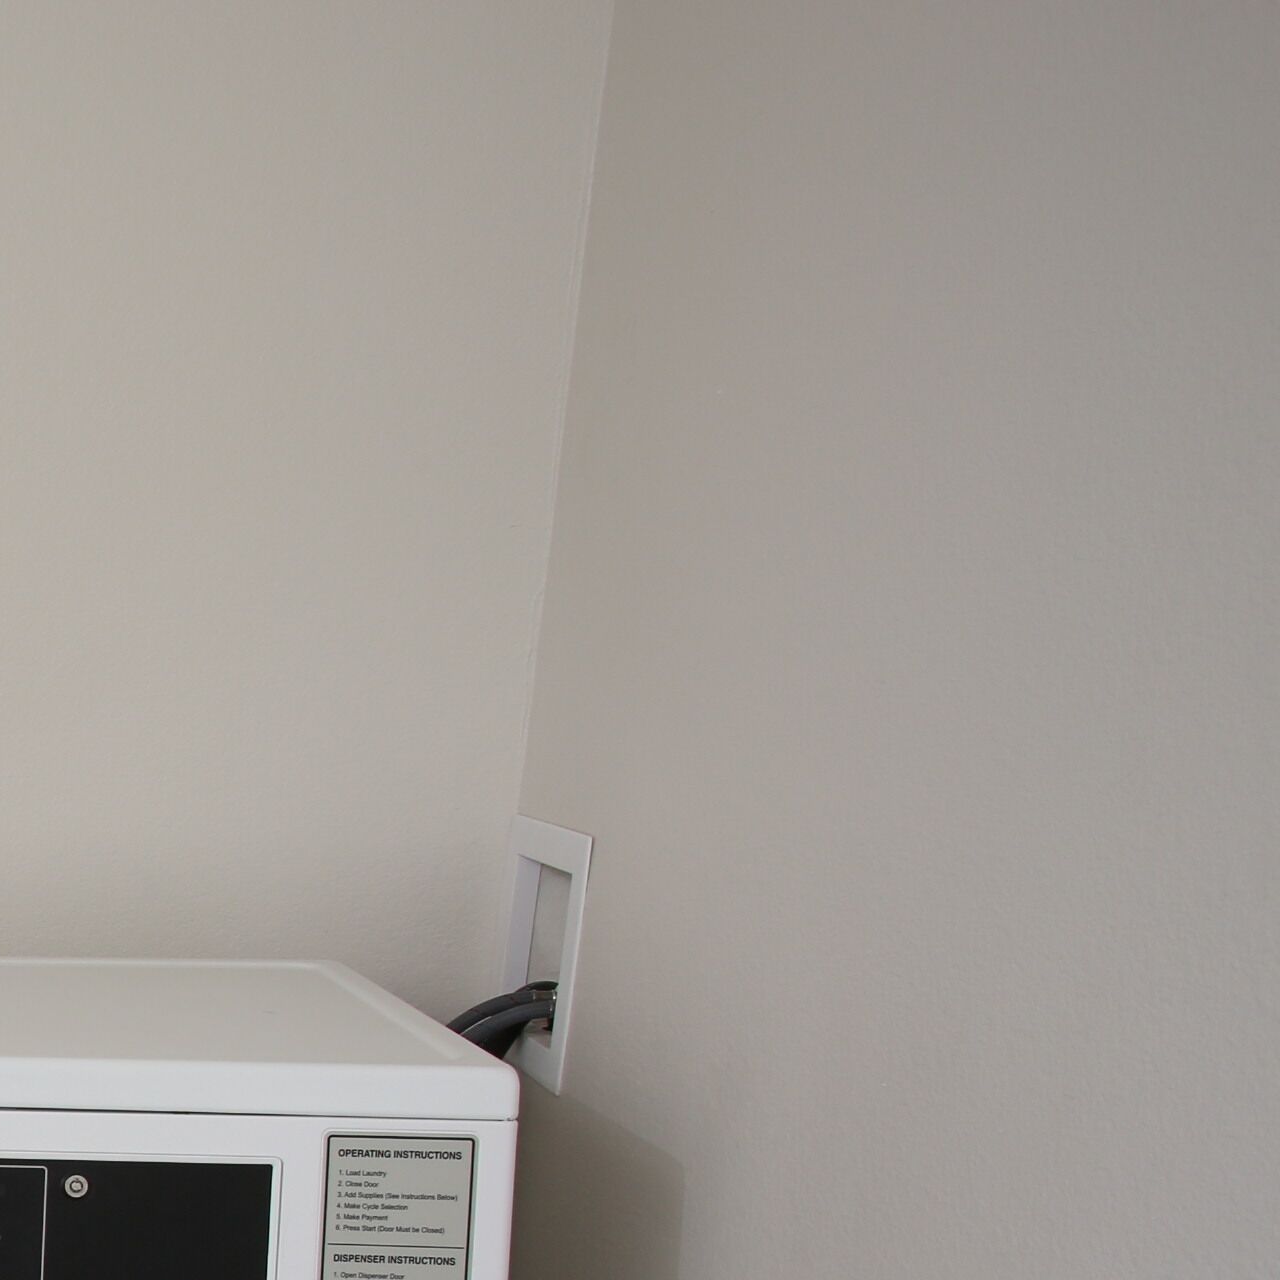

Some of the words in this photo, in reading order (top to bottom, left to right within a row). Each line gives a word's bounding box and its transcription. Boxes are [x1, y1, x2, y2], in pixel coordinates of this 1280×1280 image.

[338, 1149, 391, 1158] OPERATING
[393, 1150, 462, 1160] INSTRUCTIONS
[362, 1170, 386, 1178] Laundry
[333, 1254, 385, 1264] DISPENSER
[388, 1255, 456, 1265] INSTRUCTIONS
[358, 1272, 388, 1280] Dispenser
